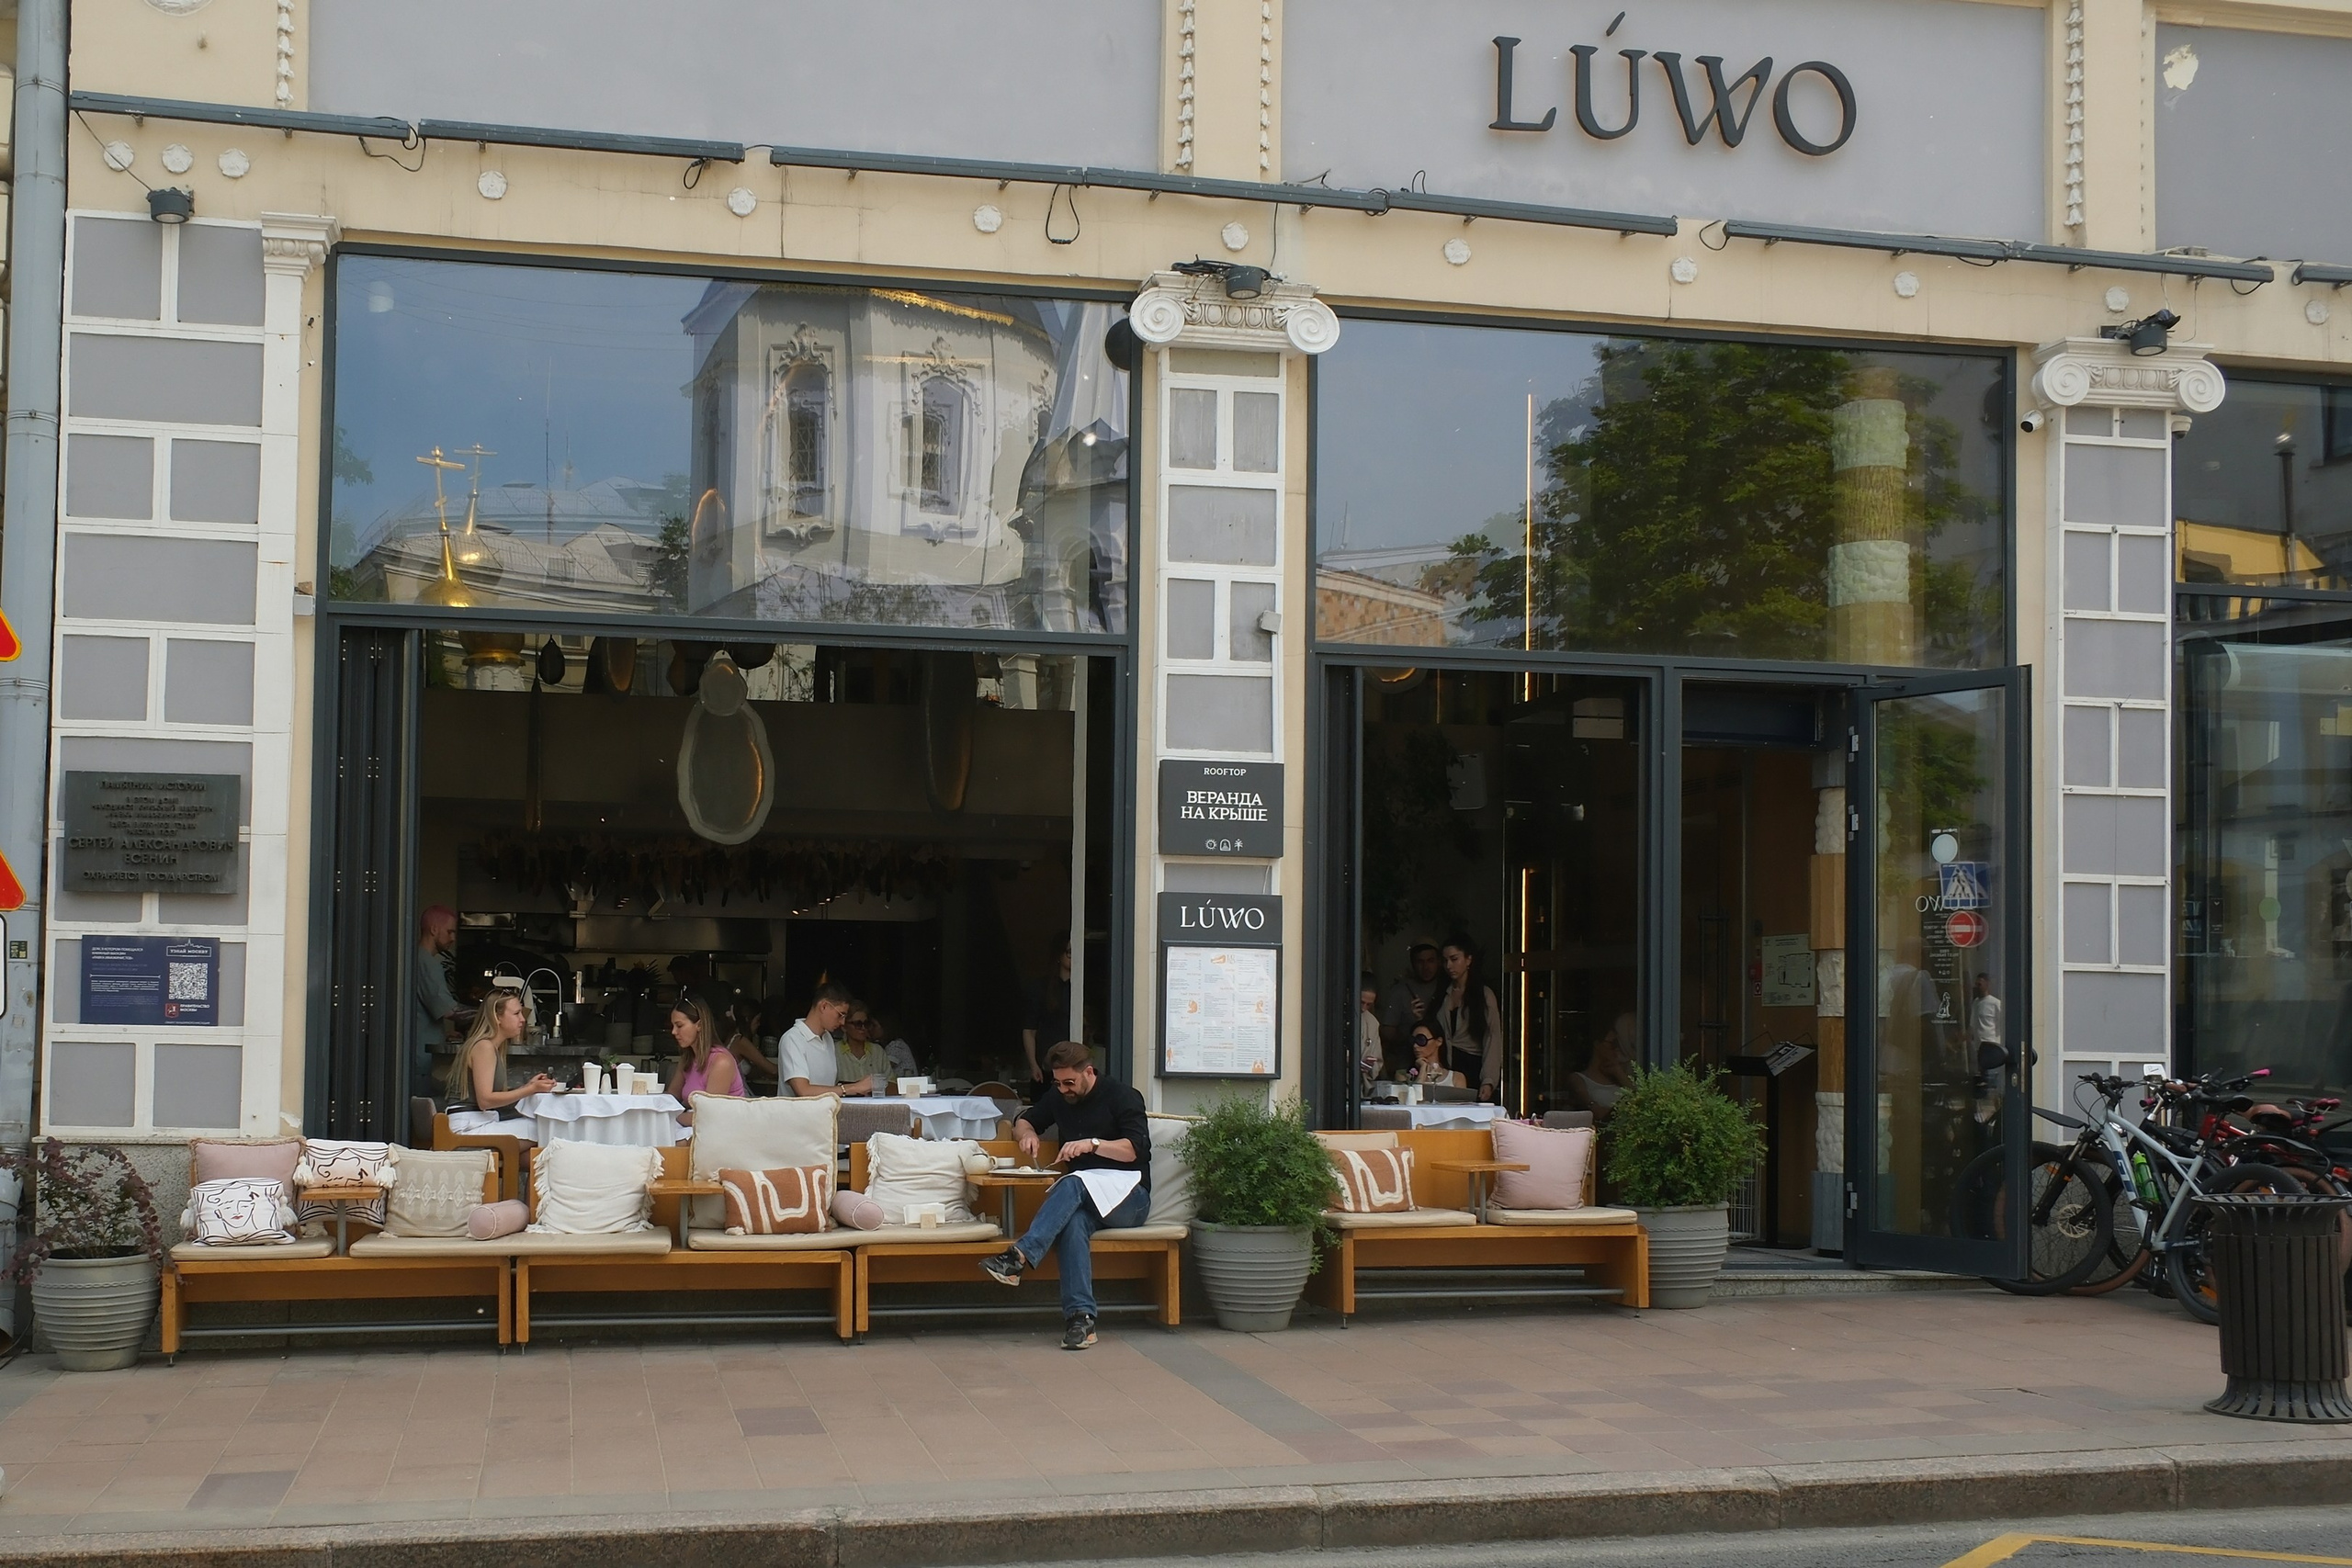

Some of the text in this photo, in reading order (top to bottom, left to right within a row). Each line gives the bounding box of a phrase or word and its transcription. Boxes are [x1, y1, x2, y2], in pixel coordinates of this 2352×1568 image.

[1488, 11, 1857, 156] LÚWO
[1204, 767, 1247, 776] ROOFTOP
[1186, 790, 1263, 807] ВЕРАНДА
[1180, 806, 1269, 821] НА КРЫШЕ
[68, 837, 235, 852] СЕРГЕЙ АЛЕКСАНДРОВИЧ
[124, 853, 179, 865] ЕСЕНИН
[83, 871, 220, 883] ОХРАНЯЕТСЯ ГОСУДАРСТВОМ
[1180, 898, 1265, 931] LÚWO
